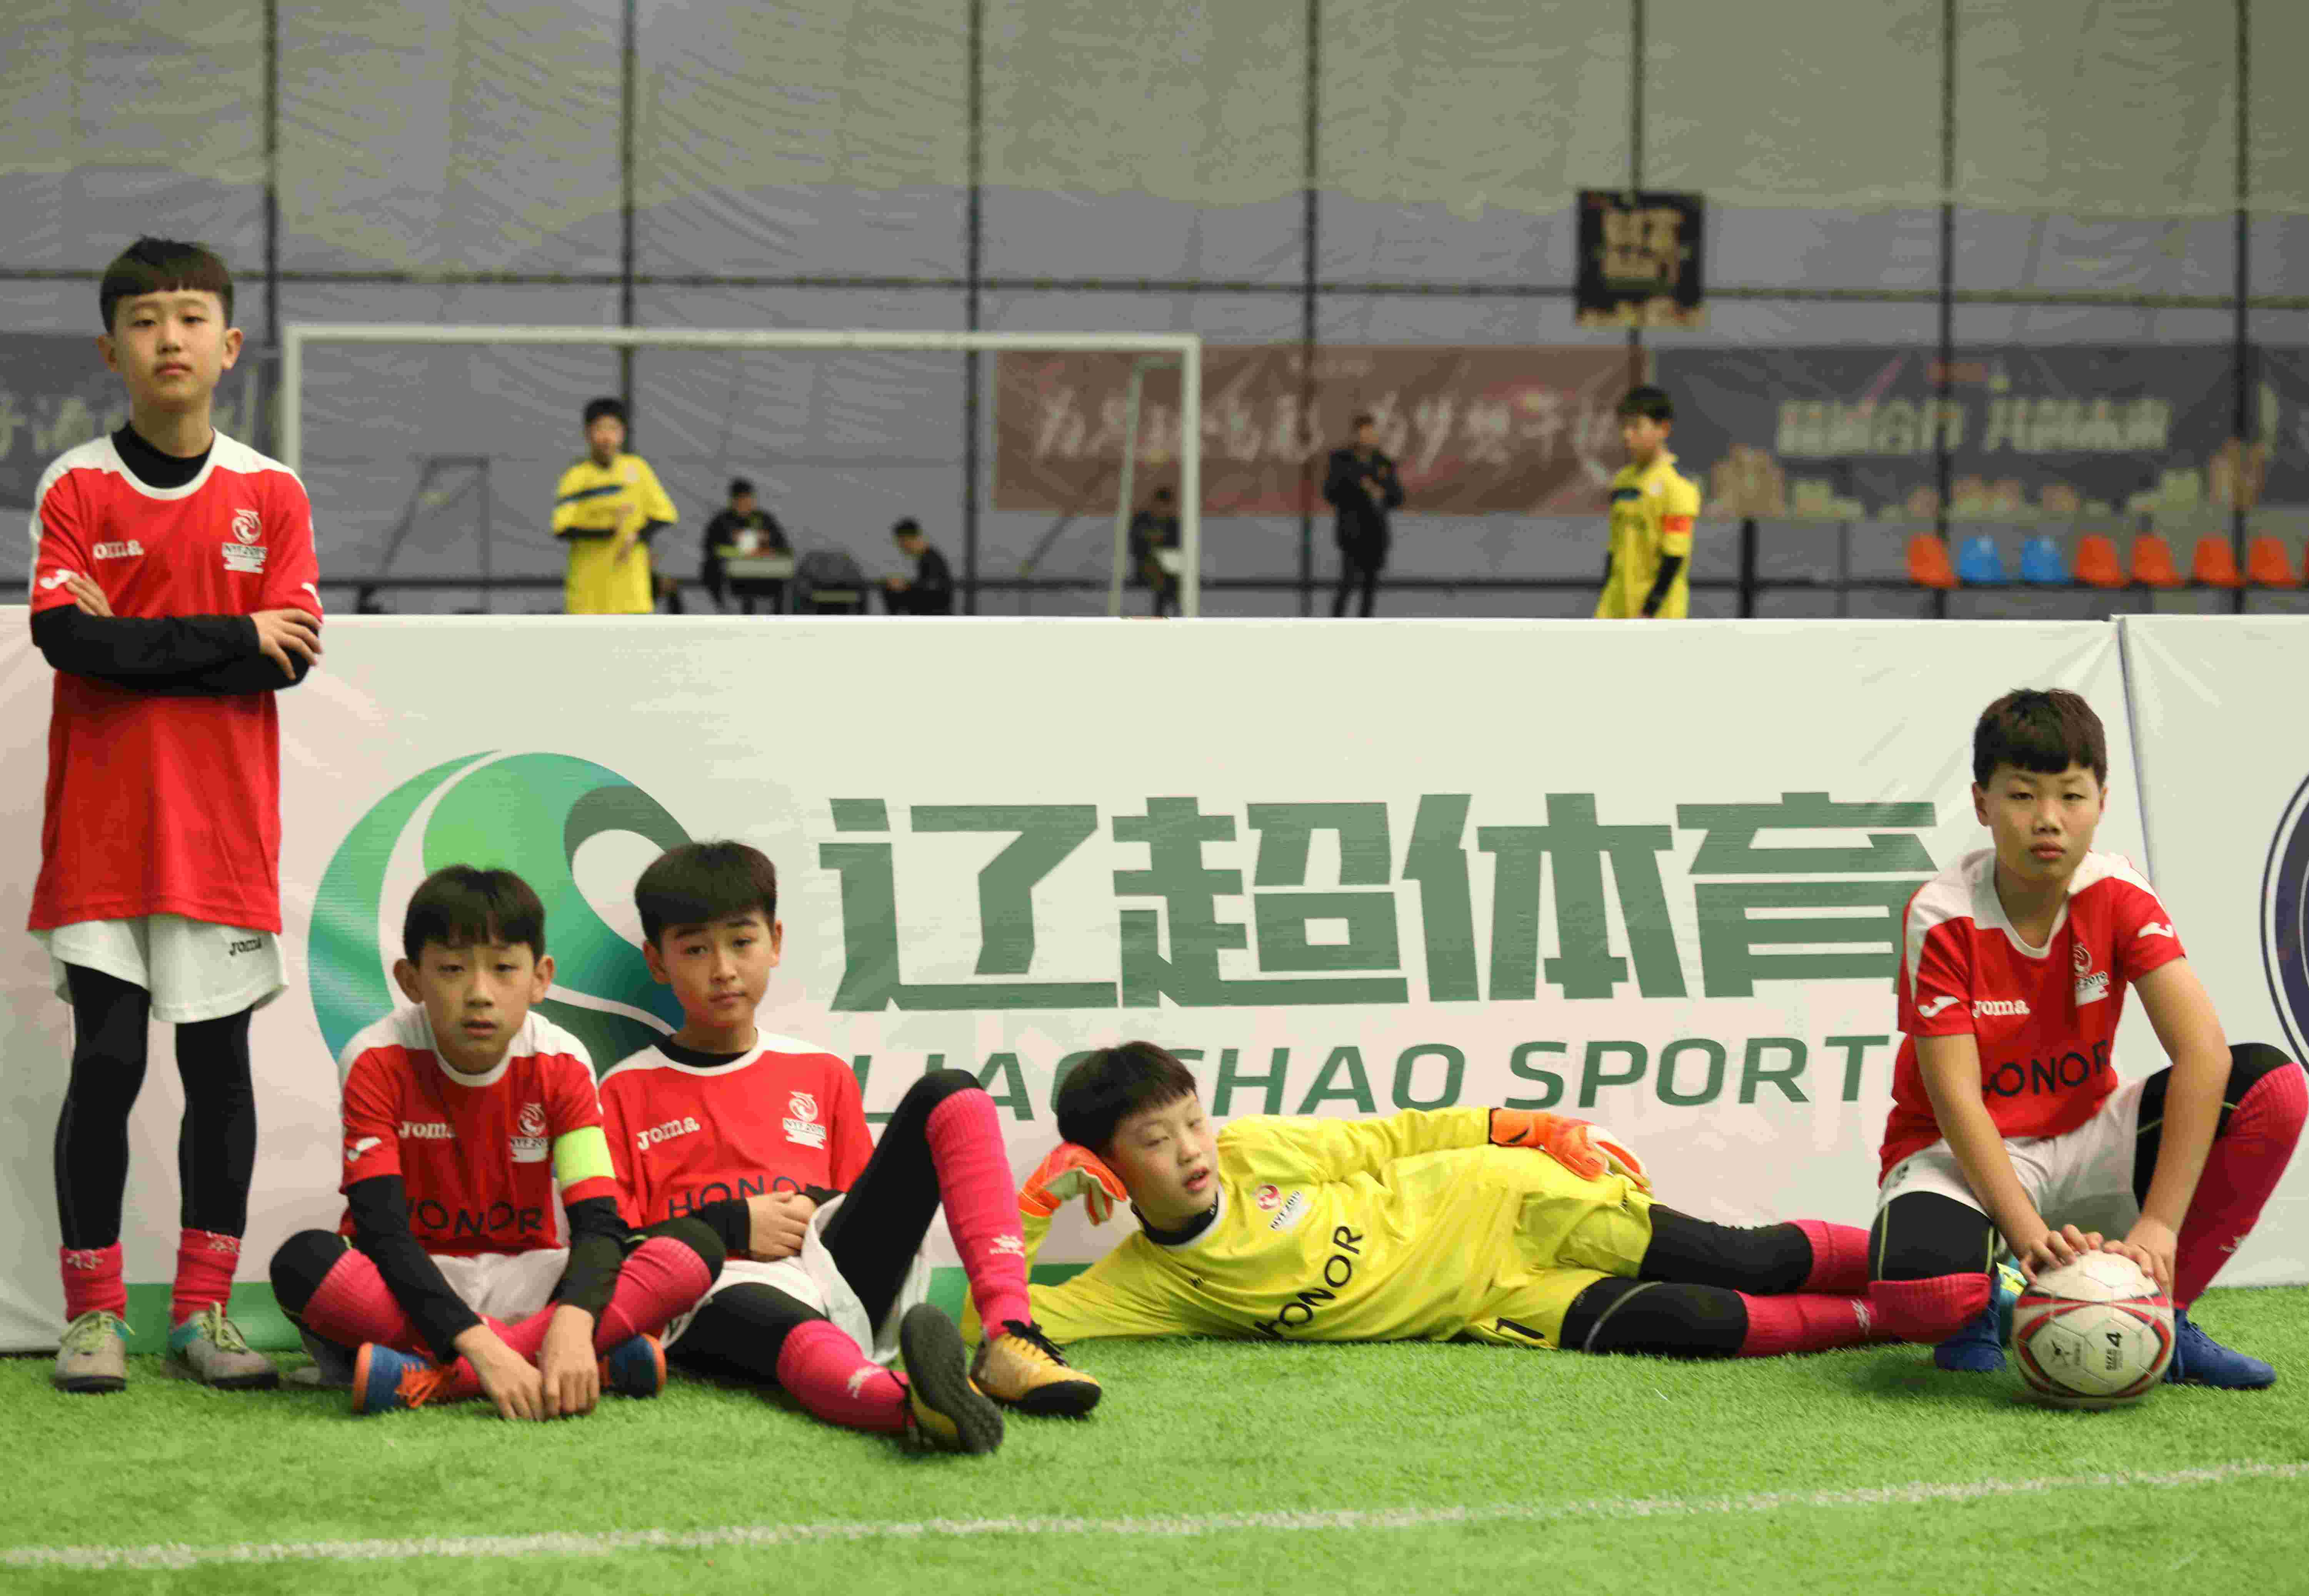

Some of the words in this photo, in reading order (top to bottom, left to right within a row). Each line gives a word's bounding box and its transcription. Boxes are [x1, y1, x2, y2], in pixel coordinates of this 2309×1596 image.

[819, 791, 1939, 1012] 辽超体育
[2106, 1331, 2122, 1347] 4
